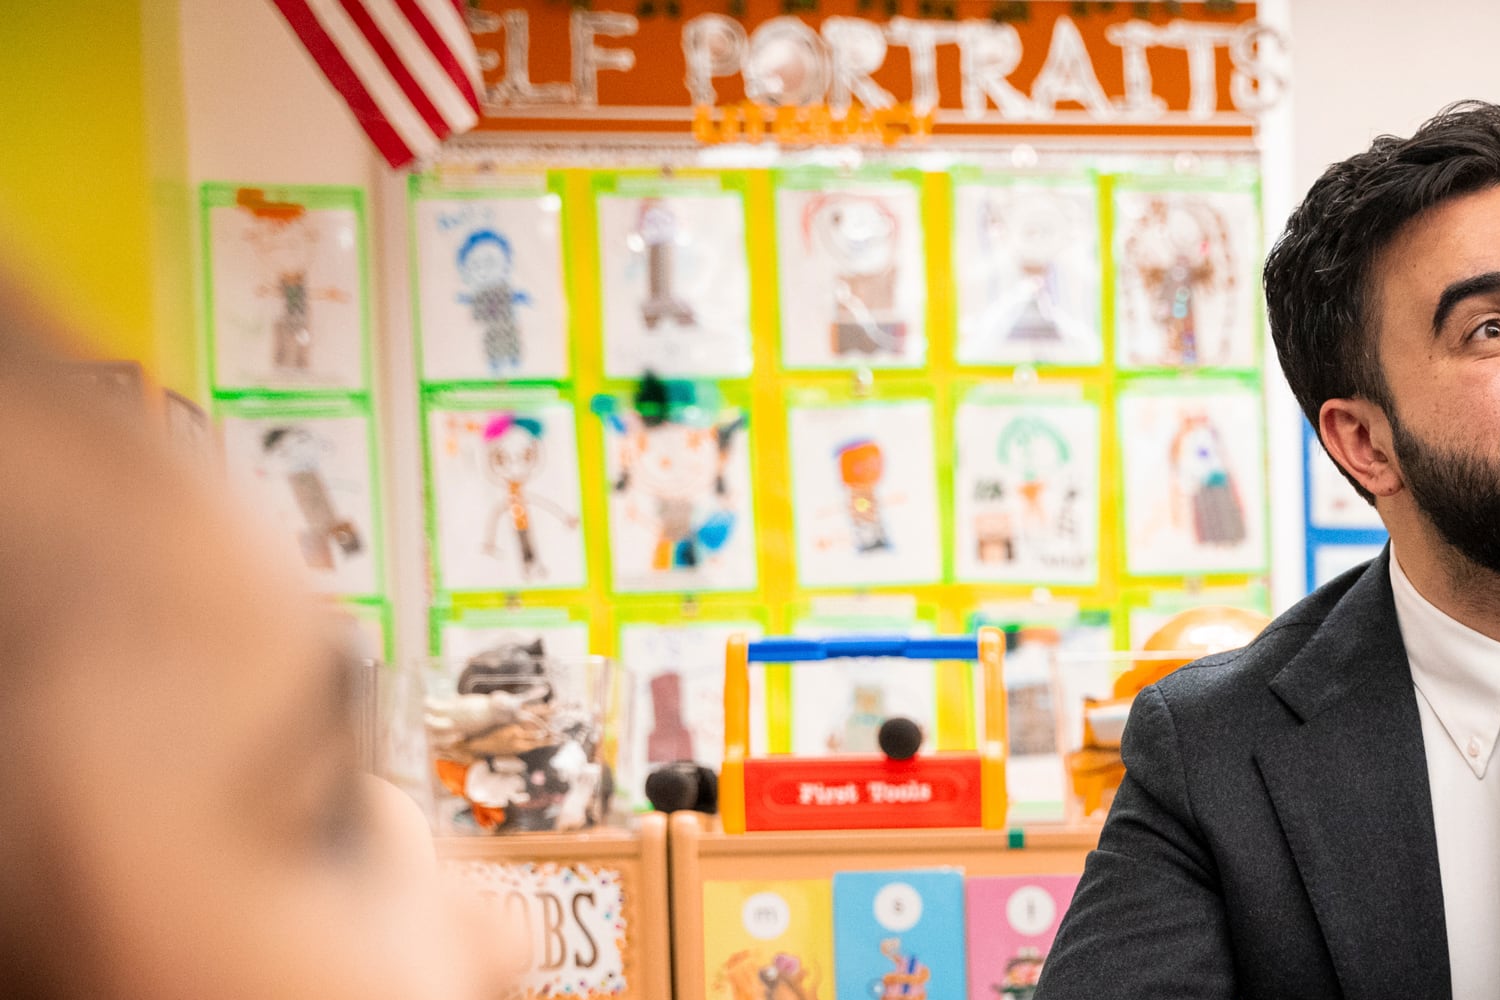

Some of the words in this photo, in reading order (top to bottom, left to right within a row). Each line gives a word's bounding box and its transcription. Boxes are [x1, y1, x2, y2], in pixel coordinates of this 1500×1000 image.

[682, 13, 1289, 120] PORTRAITS
[798, 782, 860, 805] First
[866, 780, 932, 803] Tools
